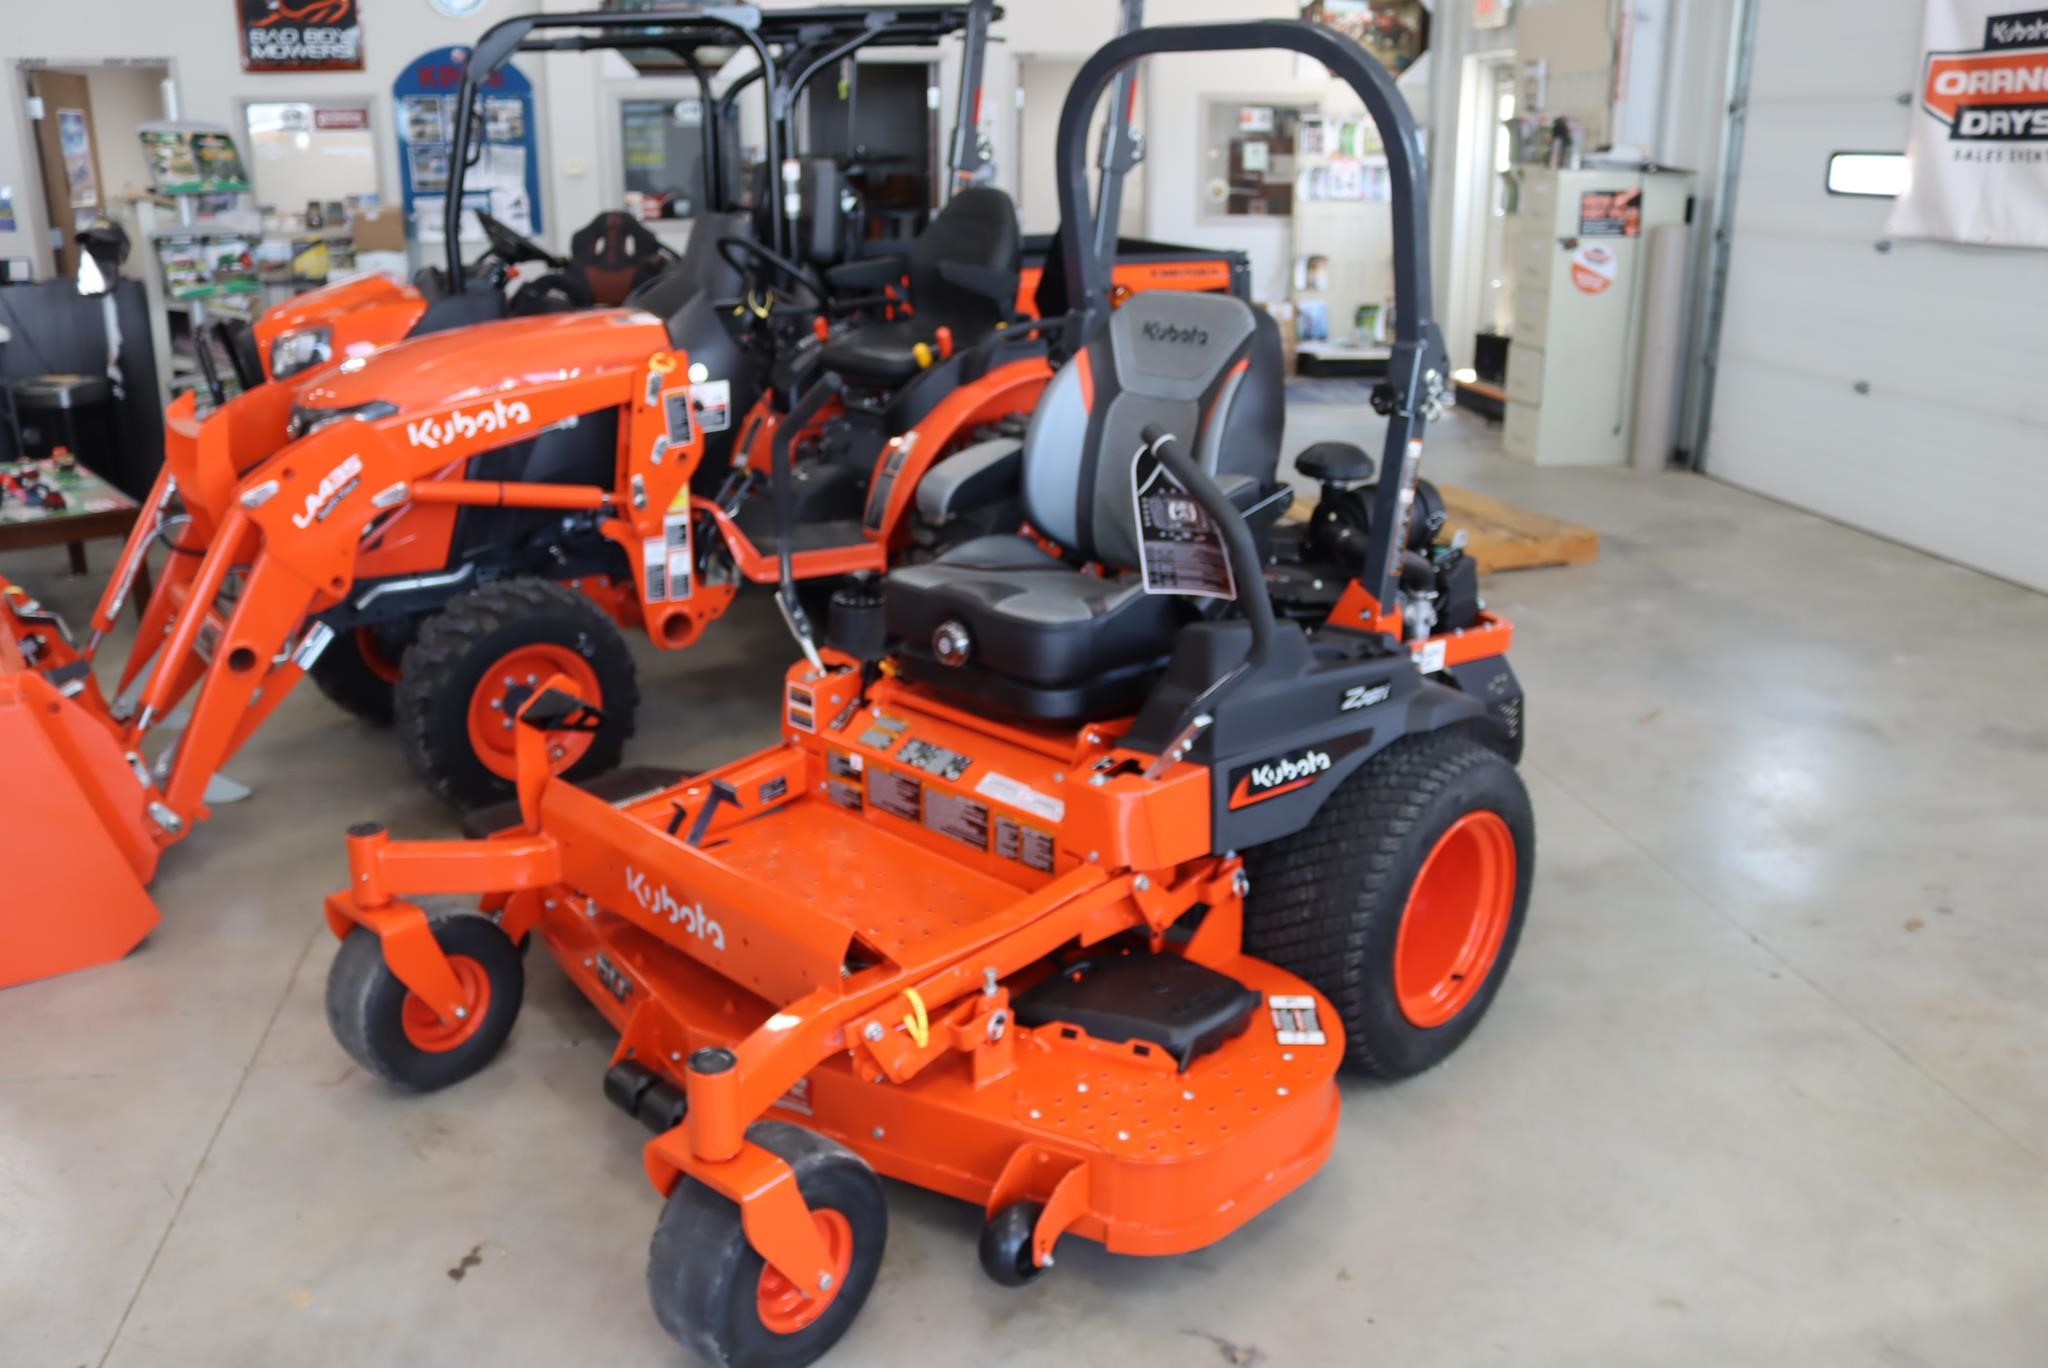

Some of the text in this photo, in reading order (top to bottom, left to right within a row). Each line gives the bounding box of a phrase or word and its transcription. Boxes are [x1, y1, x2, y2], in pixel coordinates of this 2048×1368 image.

[248, 26, 358, 46] BAD BOY
[251, 44, 356, 60] MOWERS
[1933, 65, 2048, 95] ORAN
[1143, 320, 1209, 346] Kubota
[407, 399, 532, 449] Kubota
[1251, 750, 1332, 788] Kubota
[625, 865, 725, 951] Kubota
